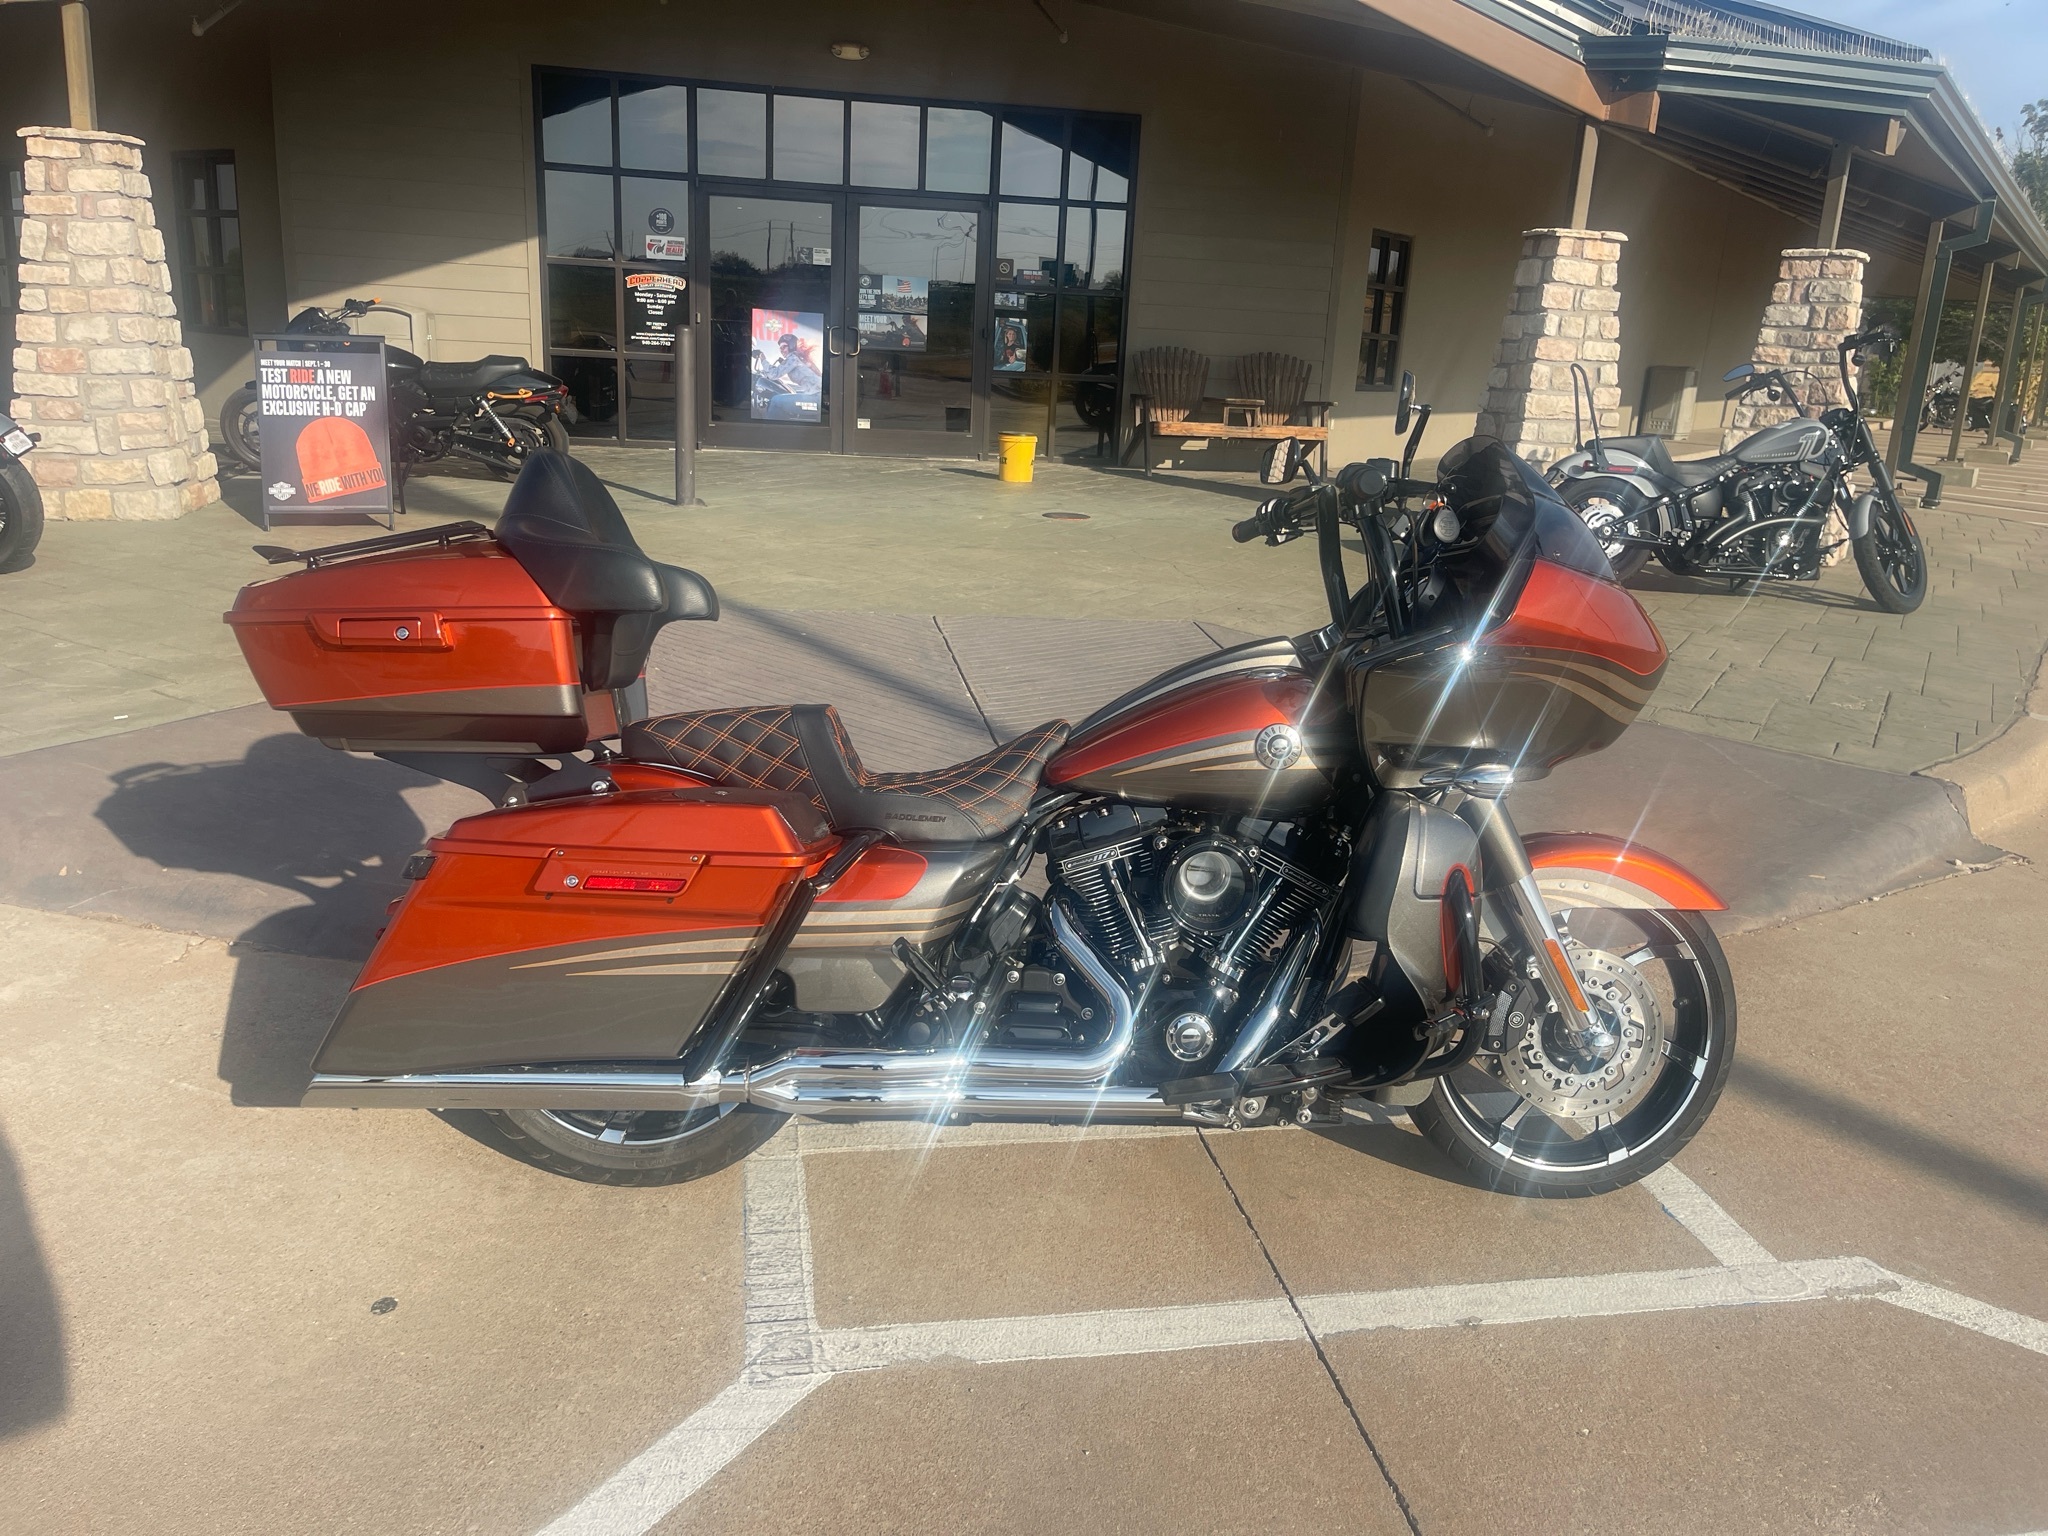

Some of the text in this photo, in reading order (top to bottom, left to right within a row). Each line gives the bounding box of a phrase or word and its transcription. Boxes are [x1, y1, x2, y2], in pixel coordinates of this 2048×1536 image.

[628, 274, 684, 288] COPPERHEAD
[260, 367, 351, 384] TEST RIDE A NEW
[261, 383, 375, 402] MOTORCYCLE, GET AN
[262, 400, 320, 416] EXCLUSIVE
[317, 477, 343, 496] RIDE
[340, 471, 368, 490] WITH
[884, 812, 947, 823] SADDLEMEN
